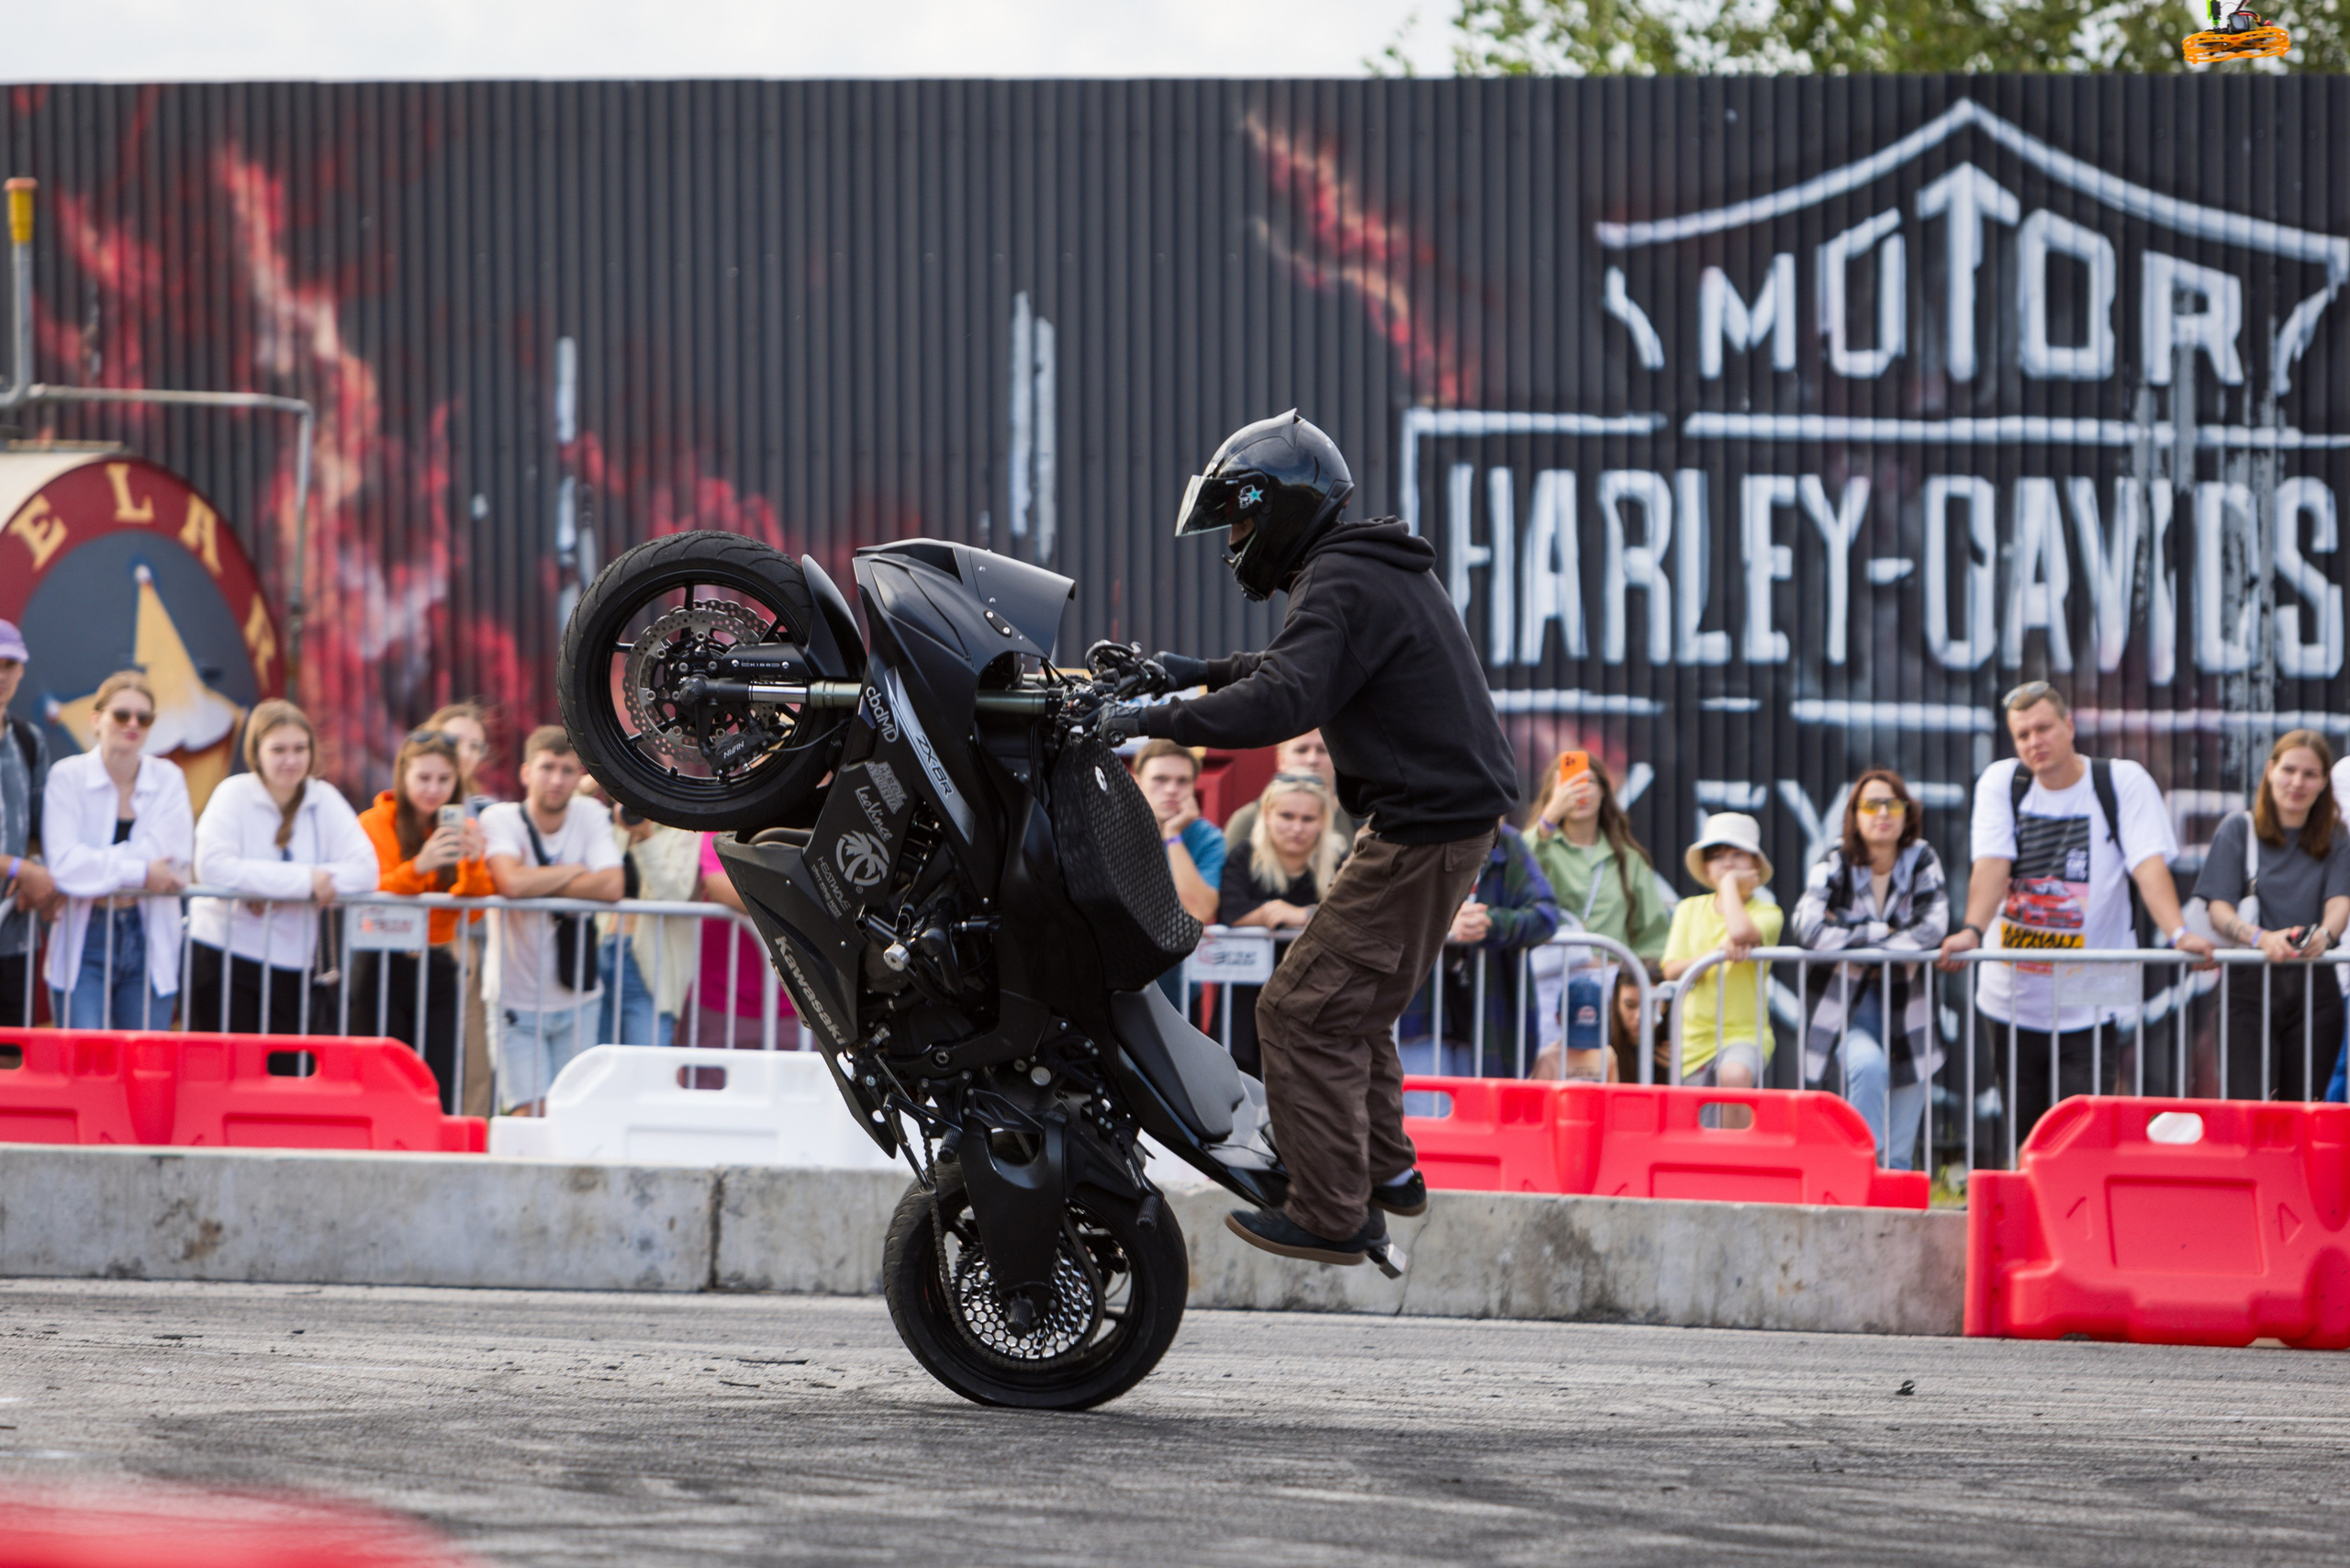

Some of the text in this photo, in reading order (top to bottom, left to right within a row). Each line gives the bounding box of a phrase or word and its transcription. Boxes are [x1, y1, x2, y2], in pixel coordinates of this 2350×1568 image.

[1699, 162, 2244, 386] MOTOR
[866, 686, 899, 743] cbdMD
[723, 740, 744, 760] NISSIN
[916, 734, 954, 800] ZX-6R
[855, 786, 893, 843] LeoVince
[818, 856, 852, 911] HEATWAVE
[775, 935, 847, 1046] Kawasaki
